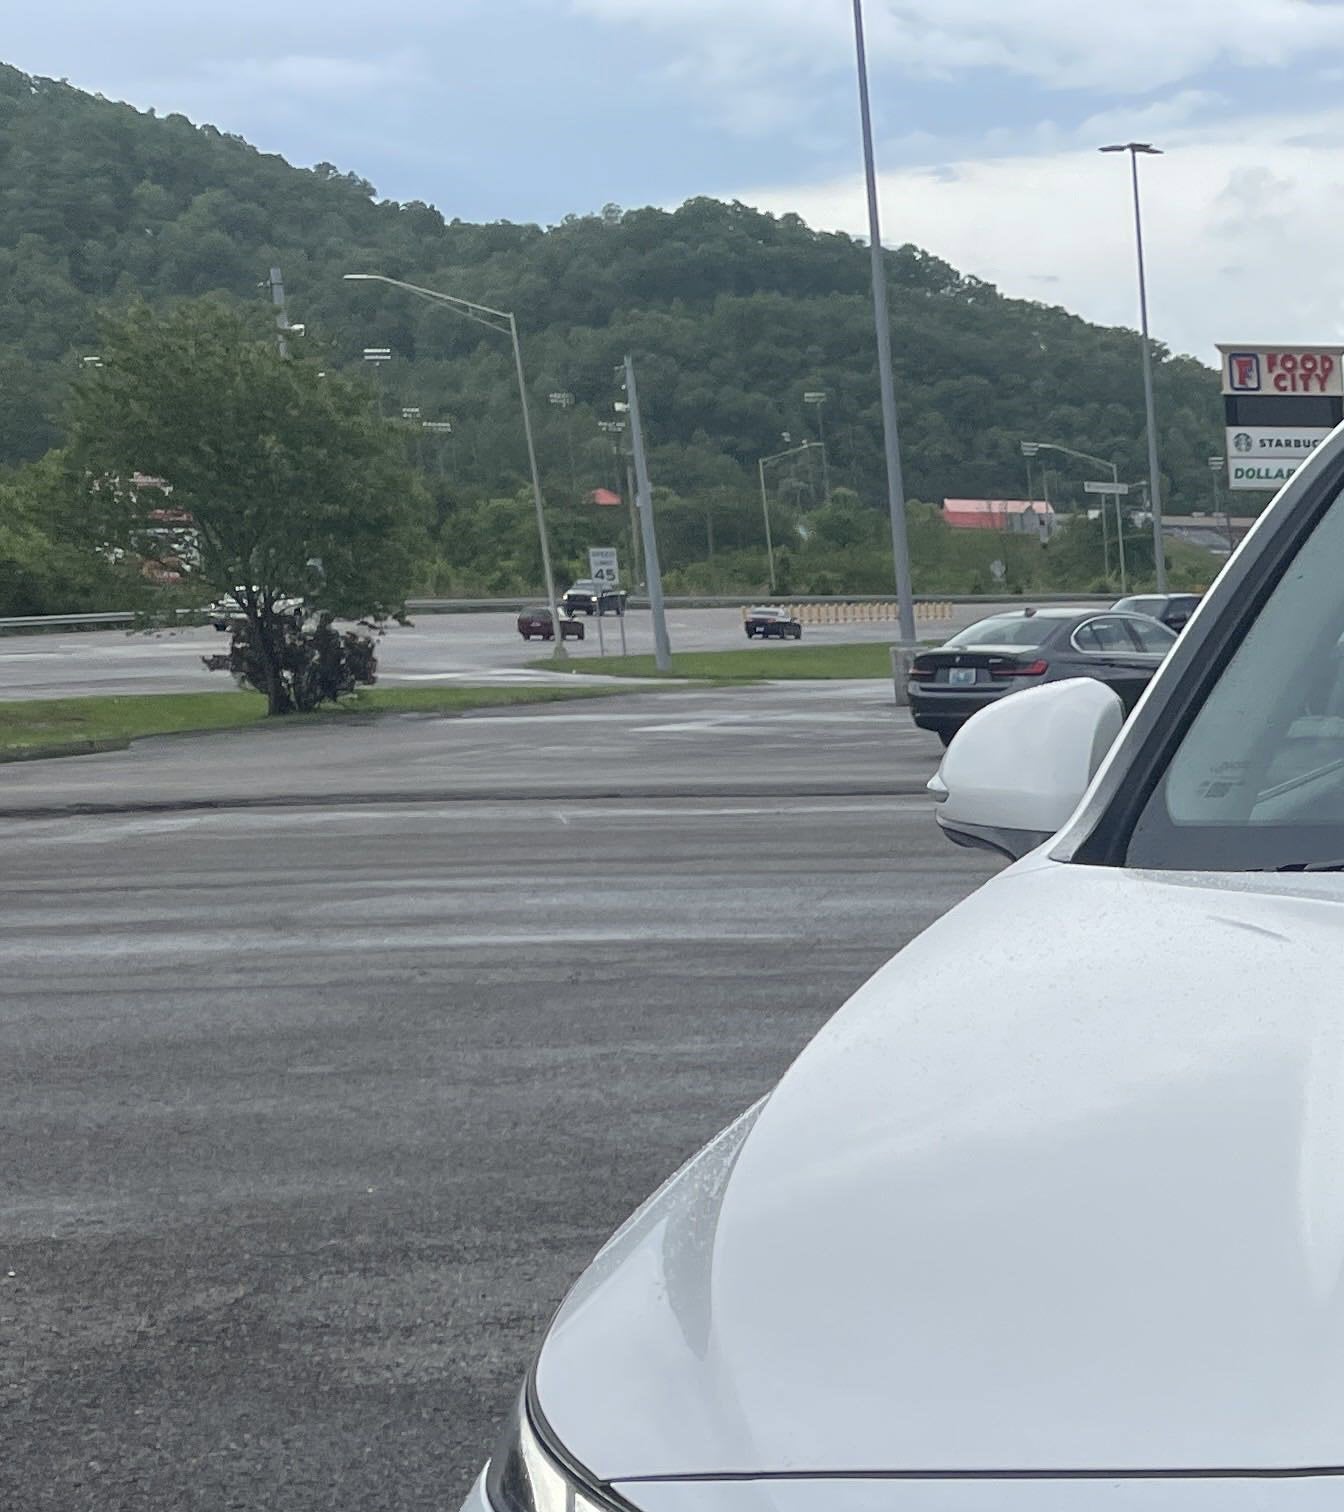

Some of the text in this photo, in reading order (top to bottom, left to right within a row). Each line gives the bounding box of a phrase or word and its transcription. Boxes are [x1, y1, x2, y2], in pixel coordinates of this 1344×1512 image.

[1266, 353, 1333, 373] FOOD
[1273, 373, 1329, 392] CITY
[594, 568, 616, 581] 45
